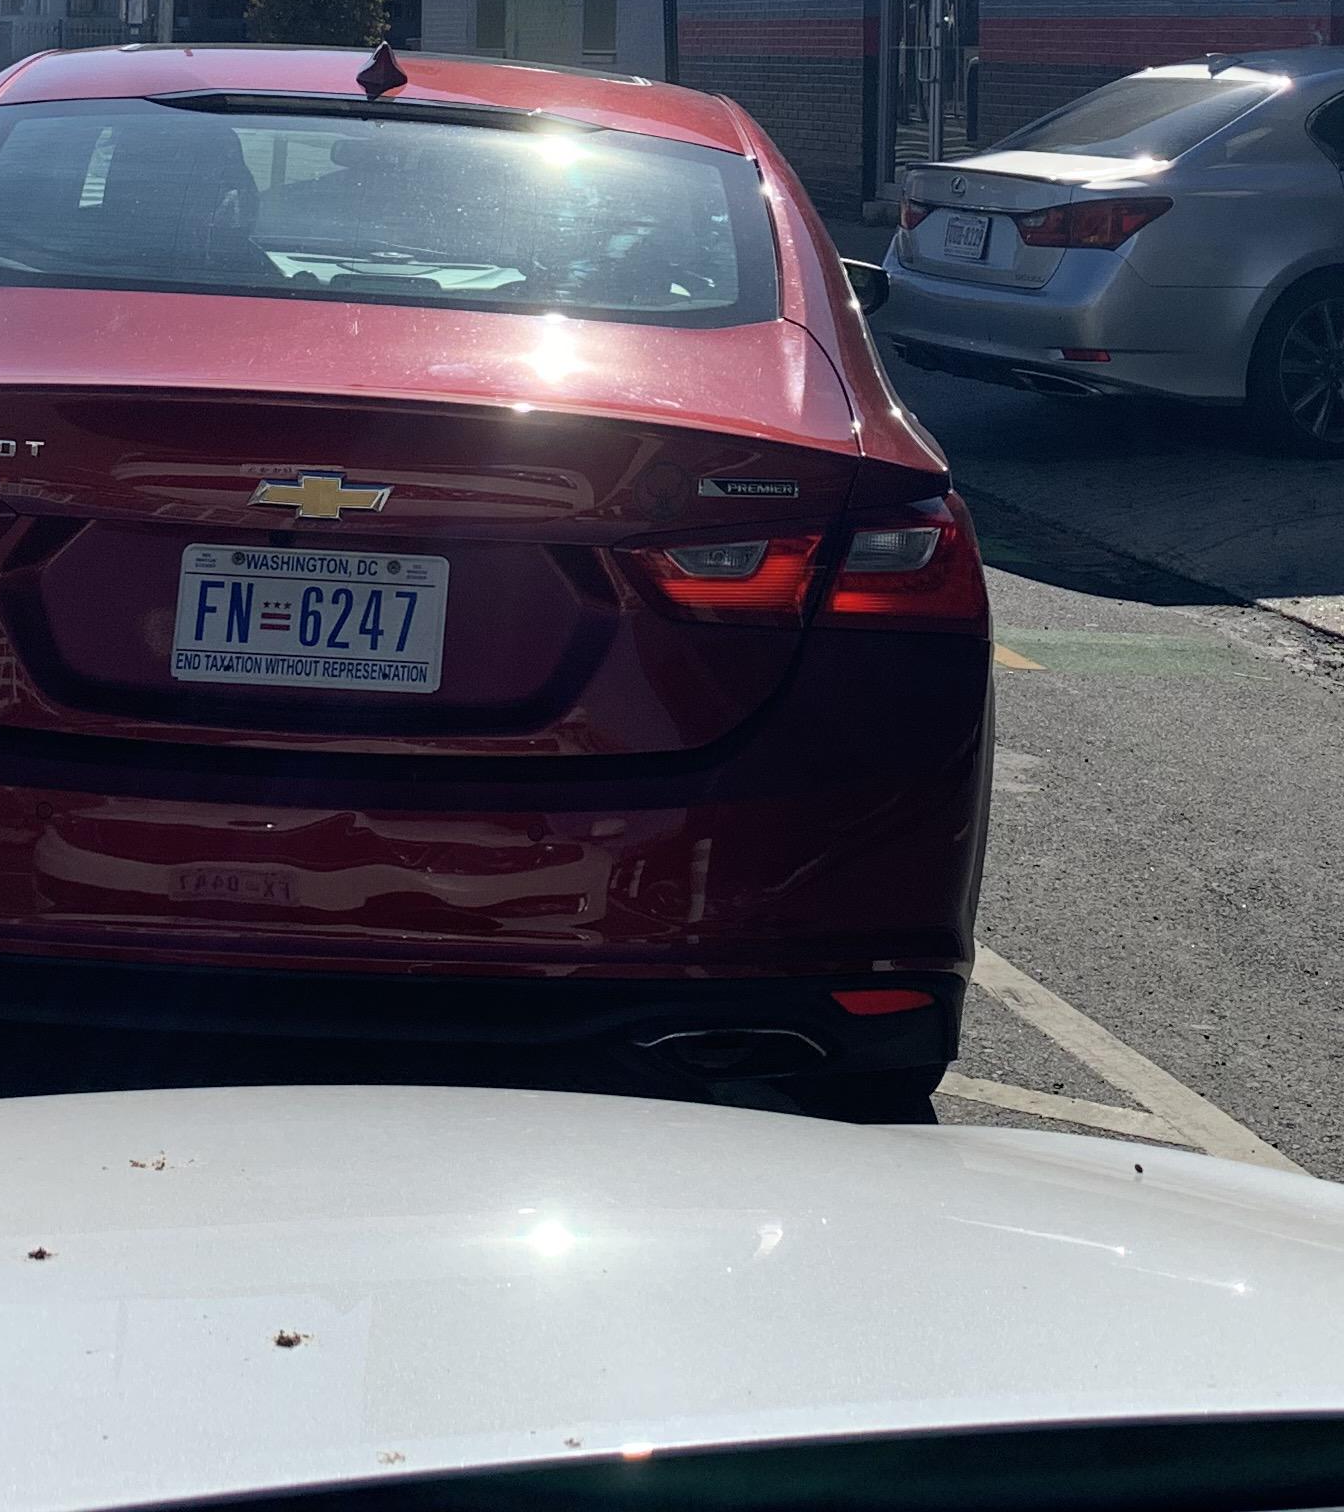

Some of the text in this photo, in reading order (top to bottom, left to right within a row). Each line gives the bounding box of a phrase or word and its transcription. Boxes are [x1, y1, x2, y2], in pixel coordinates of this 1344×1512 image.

[24, 440, 45, 457] T
[727, 482, 794, 494] PREMIER
[246, 554, 378, 579] WASHINGTON, DC
[193, 580, 418, 653] FN 6247
[176, 652, 428, 684] END TAXATION WITHOUT REPRESENTATION
